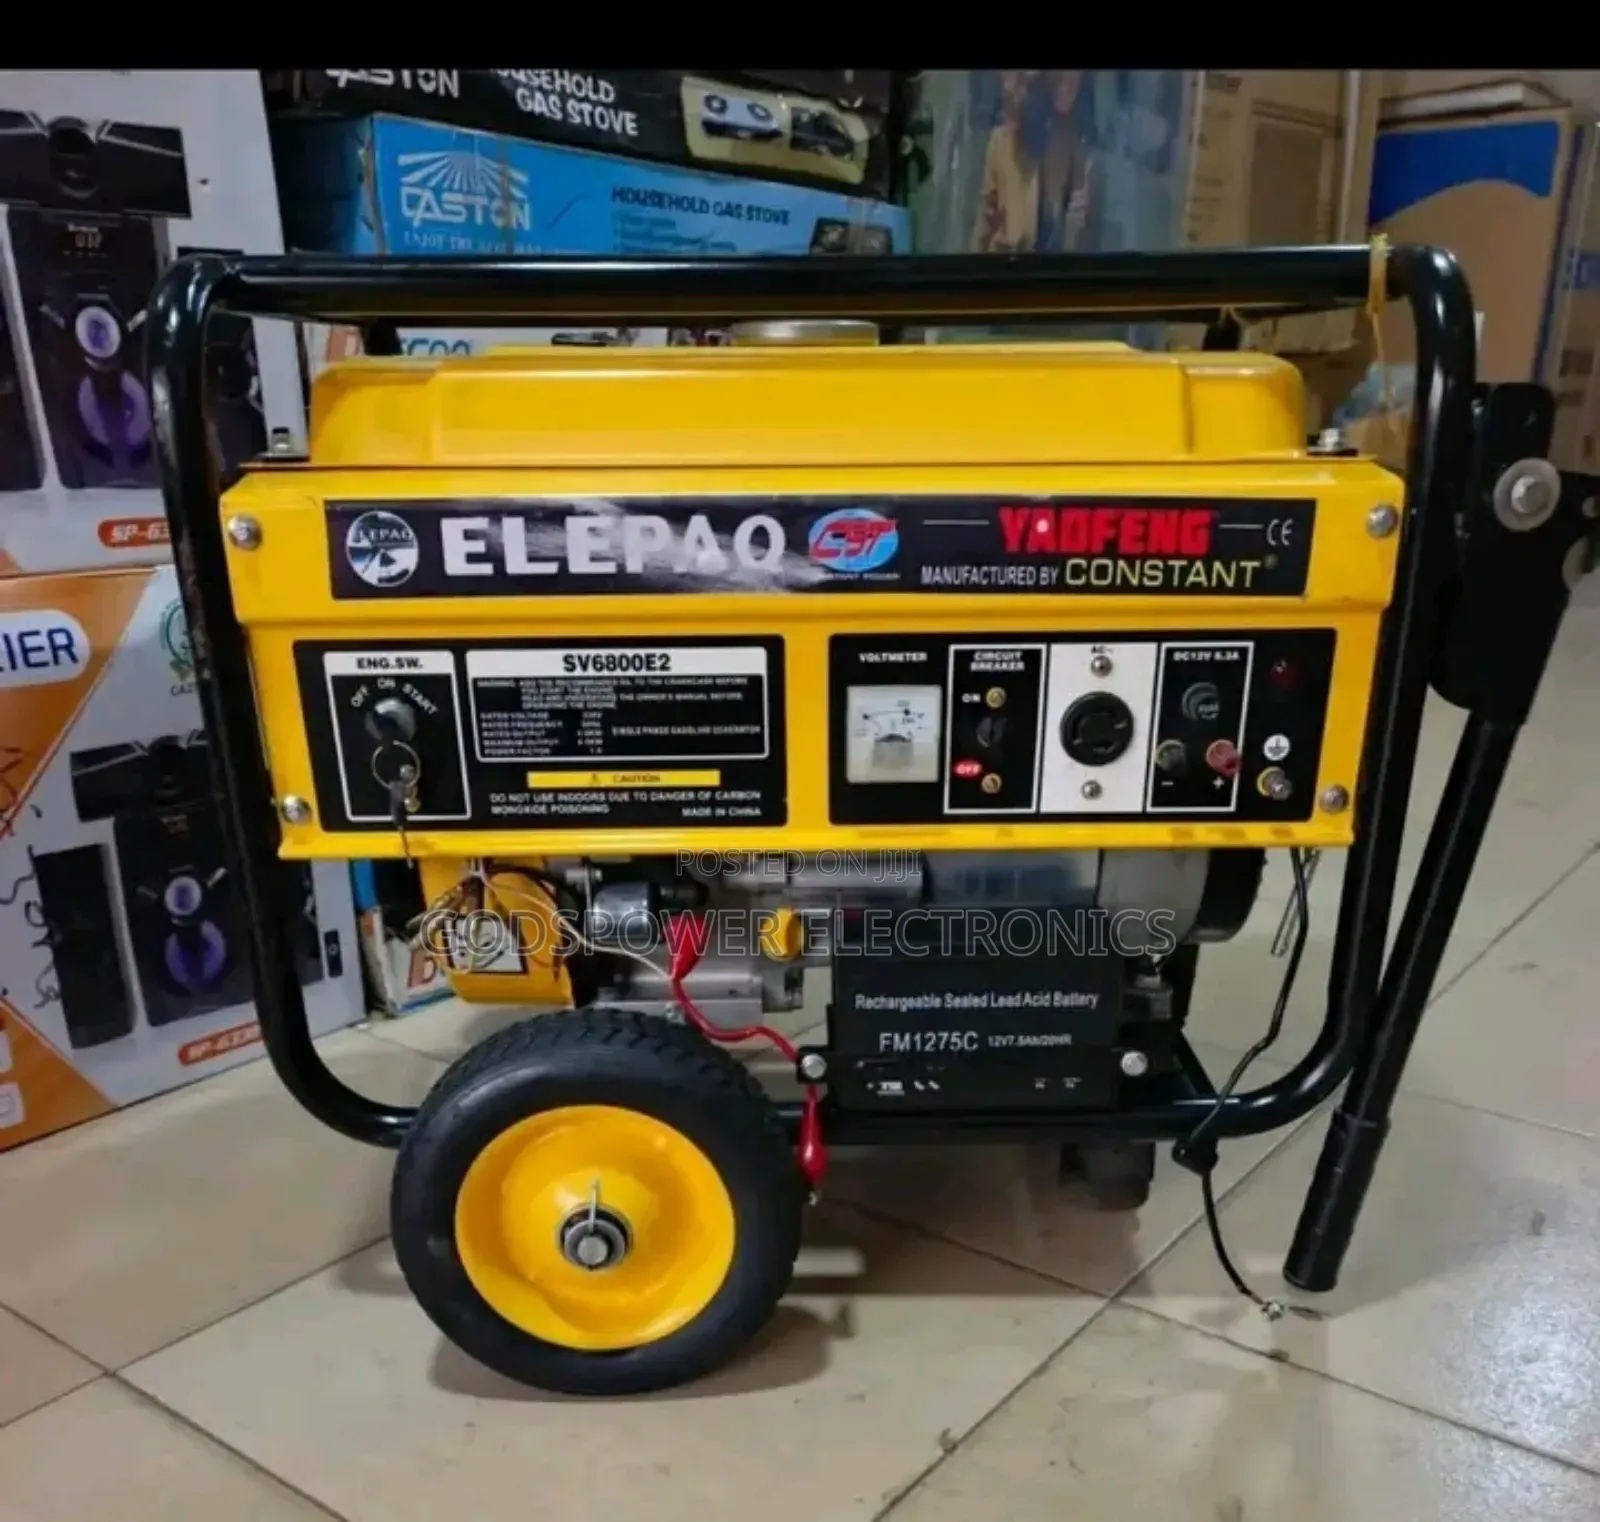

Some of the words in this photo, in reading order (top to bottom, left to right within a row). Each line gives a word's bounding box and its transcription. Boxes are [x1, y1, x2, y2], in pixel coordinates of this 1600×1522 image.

[515, 87, 563, 121] GAS
[566, 97, 639, 137] STOVE
[401, 186, 531, 231] CASTON
[612, 186, 710, 215] HOUSEHOLD
[713, 203, 743, 220] GAS
[746, 207, 790, 226] STOVE
[439, 515, 787, 577] ELEPAQ
[920, 564, 1036, 586] MANUFACTURED
[1038, 566, 1059, 586] BY
[1064, 557, 1261, 588] CONSTANT
[0, 627, 79, 674] IER
[858, 651, 928, 663] VOLTMETER
[355, 656, 423, 670] ENG.SW.
[562, 652, 672, 673] SV6800E2
[970, 661, 1025, 672] BREAKER
[377, 677, 396, 690] ON
[350, 684, 369, 708] OFF
[402, 682, 438, 716] START
[961, 692, 981, 703] ON
[954, 763, 983, 778] OFF
[854, 993, 942, 1012] Rechargeable
[943, 992, 988, 1009] Sealed
[990, 990, 1022, 1008] Lead
[1023, 991, 1051, 1007] Acid
[1052, 990, 1100, 1009] Battery
[879, 1031, 979, 1052] FM1275C
